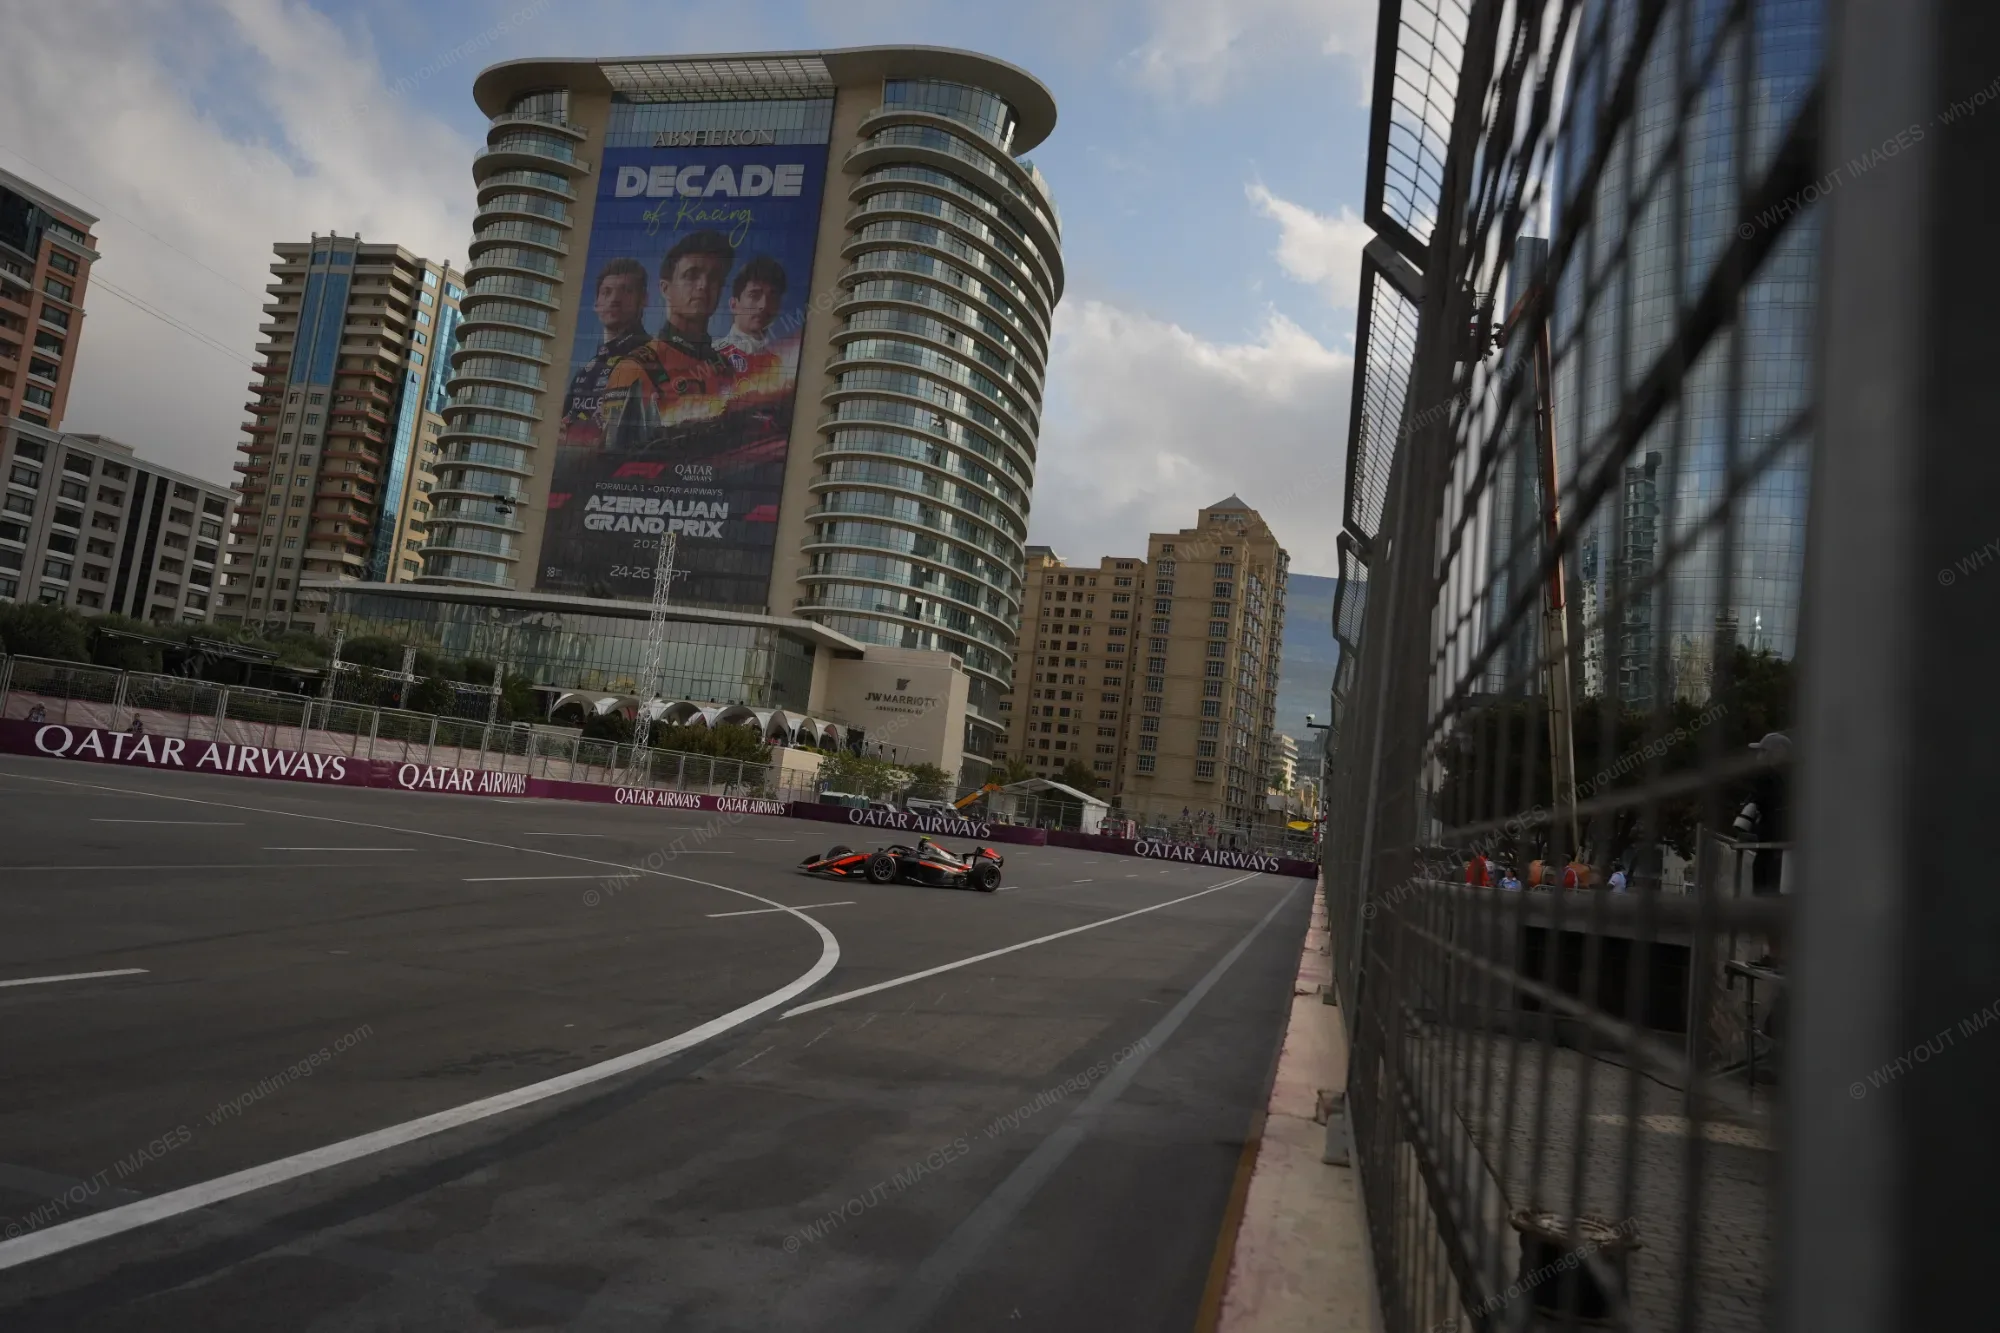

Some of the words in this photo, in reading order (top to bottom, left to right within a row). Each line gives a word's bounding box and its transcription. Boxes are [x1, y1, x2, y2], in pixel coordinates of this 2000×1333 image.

[654, 129, 776, 147] ABSHERON
[614, 164, 804, 198] DECADE
[642, 200, 667, 236] of
[673, 195, 755, 247] Racing
[674, 464, 712, 476] QATAR
[682, 474, 712, 482] AIRWAYS
[596, 482, 638, 492] FORMULA
[653, 485, 681, 494] QATAR
[684, 487, 722, 496] AIRWAYS
[584, 494, 728, 520] AZERBAIJAN
[584, 513, 664, 534] GRAND
[668, 518, 724, 538] PRIX
[634, 539, 666, 550] 202
[610, 565, 650, 580] 24-26
[653, 568, 691, 582] SPT
[864, 692, 882, 702] JW
[883, 693, 938, 707] MARRIOTT
[35, 724, 184, 766] QATAR
[196, 743, 347, 781] AIRWAYS
[398, 764, 474, 792] QATAR
[478, 771, 527, 794] AIRWAYS
[614, 788, 654, 805] QATAR
[656, 791, 701, 809] AIRWAYS
[716, 797, 747, 812] QATAR
[748, 800, 786, 816] AIRWAYS
[848, 808, 908, 828] QATAR
[913, 815, 991, 838] AIRWAYS
[1134, 841, 1196, 862] QATAR
[1200, 848, 1280, 872] AIRWAYS
